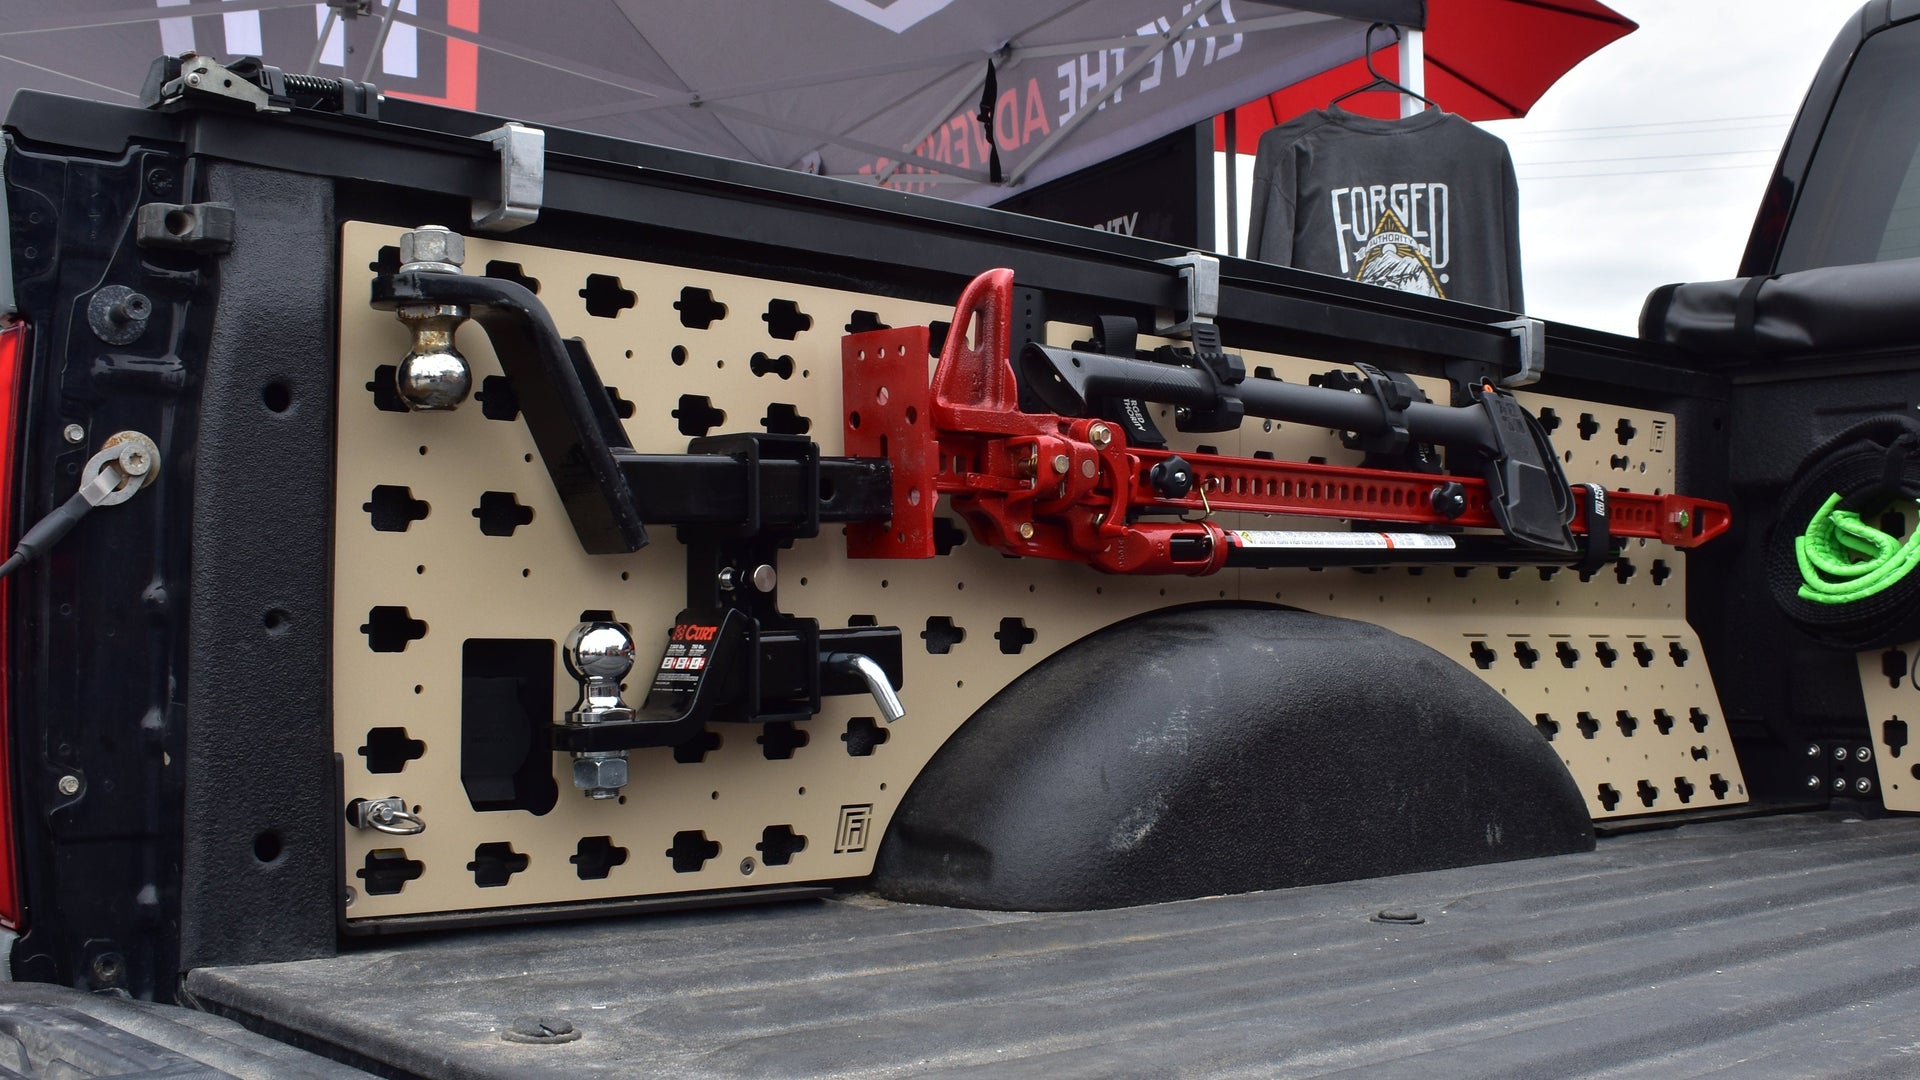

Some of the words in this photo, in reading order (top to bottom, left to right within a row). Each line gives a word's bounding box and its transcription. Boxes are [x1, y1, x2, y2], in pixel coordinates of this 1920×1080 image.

[1331, 182, 1450, 274] FORGED
[1369, 232, 1414, 247] AUTHORITY
[685, 624, 718, 641] CURT
